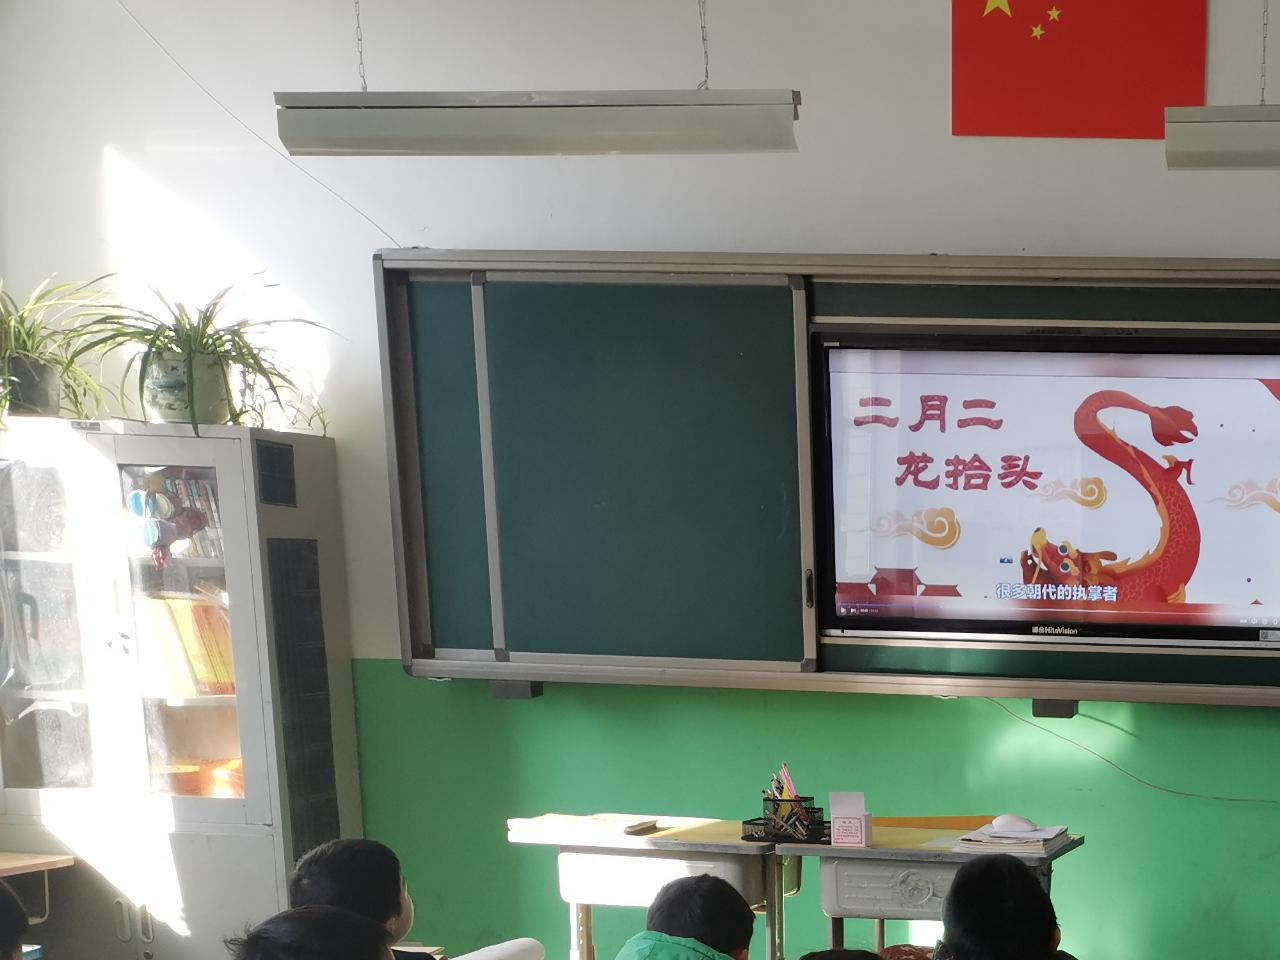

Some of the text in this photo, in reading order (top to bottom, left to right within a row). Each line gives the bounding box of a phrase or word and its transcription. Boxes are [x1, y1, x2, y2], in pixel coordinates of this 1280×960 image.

[853, 394, 1004, 433] 二月二
[894, 450, 1043, 491] 龙抬头
[995, 582, 1118, 602] 很多朝代的执掌者
